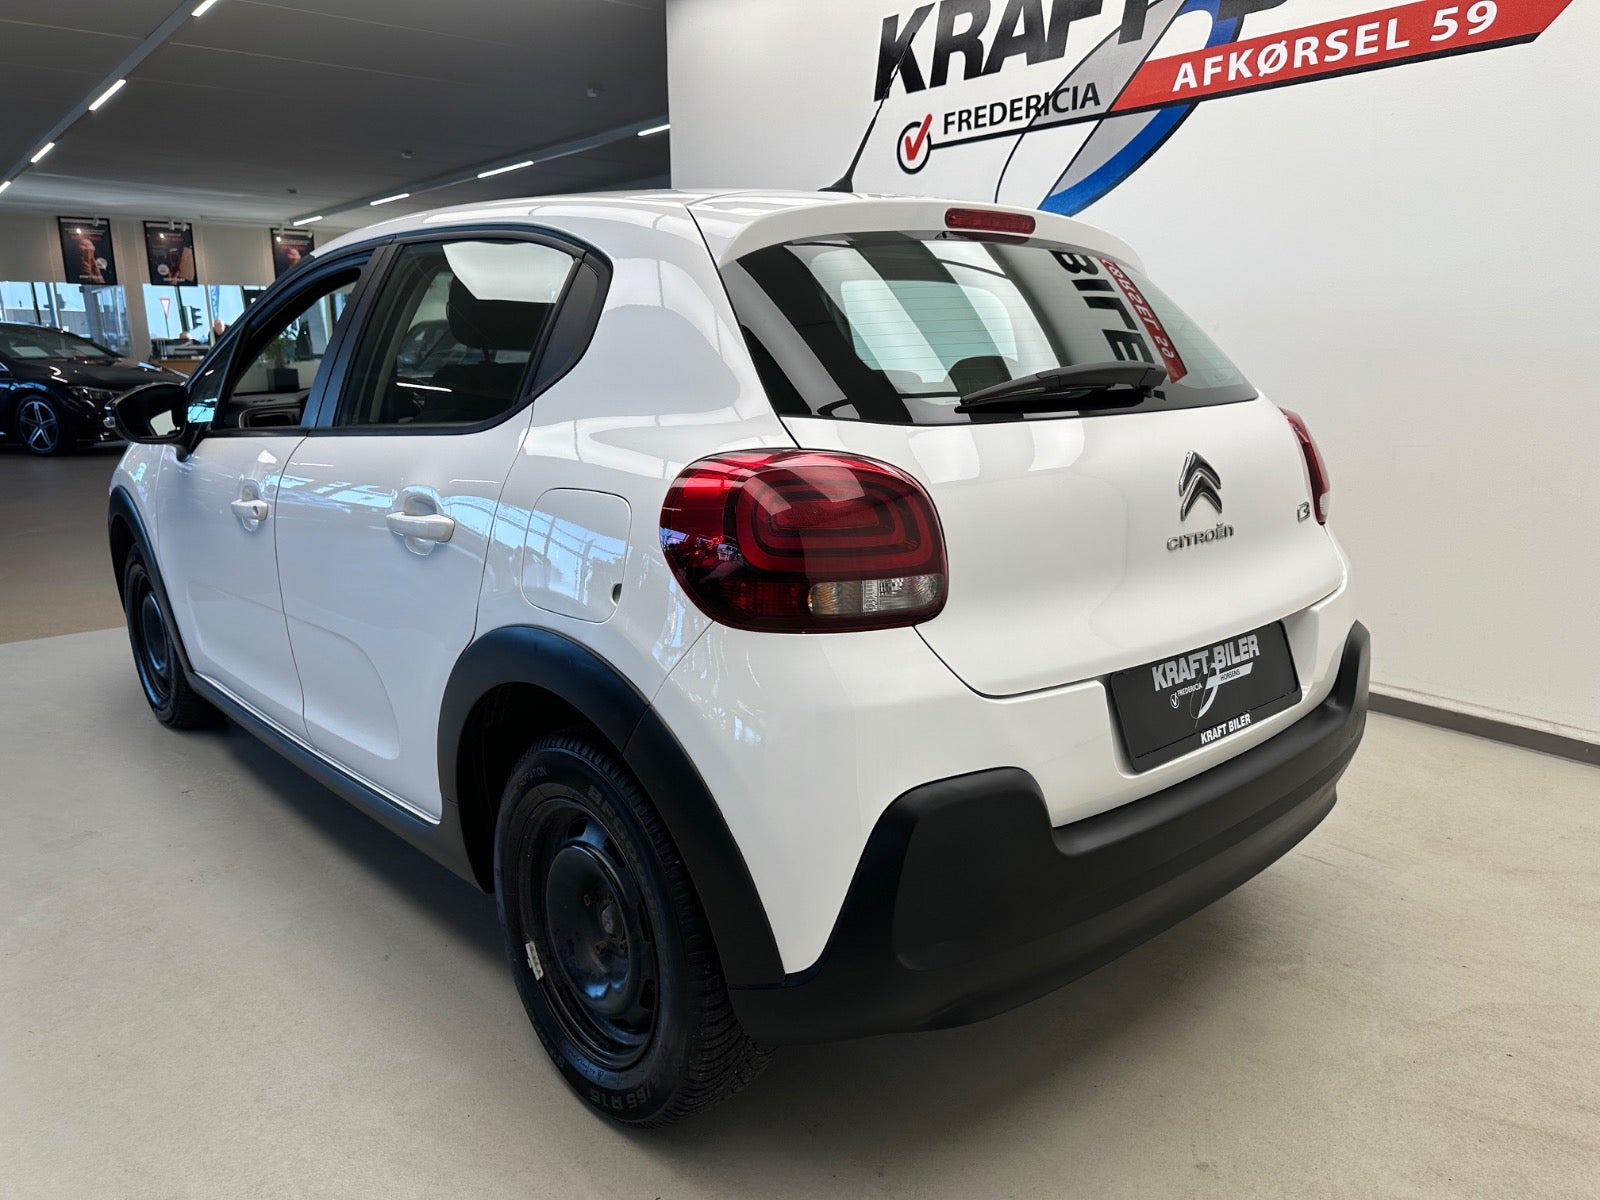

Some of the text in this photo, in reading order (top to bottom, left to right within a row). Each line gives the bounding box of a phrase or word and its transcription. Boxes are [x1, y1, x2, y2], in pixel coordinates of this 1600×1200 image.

[1172, 0, 1498, 93] AFKØRSEL 59
[943, 82, 1101, 136] FREDERICIA
[1151, 634, 1260, 692] KRAFT BILER
[1220, 669, 1241, 681] HORSENS
[1177, 682, 1203, 697] FREDERICIA
[1200, 713, 1251, 745] KRAFT BILER
